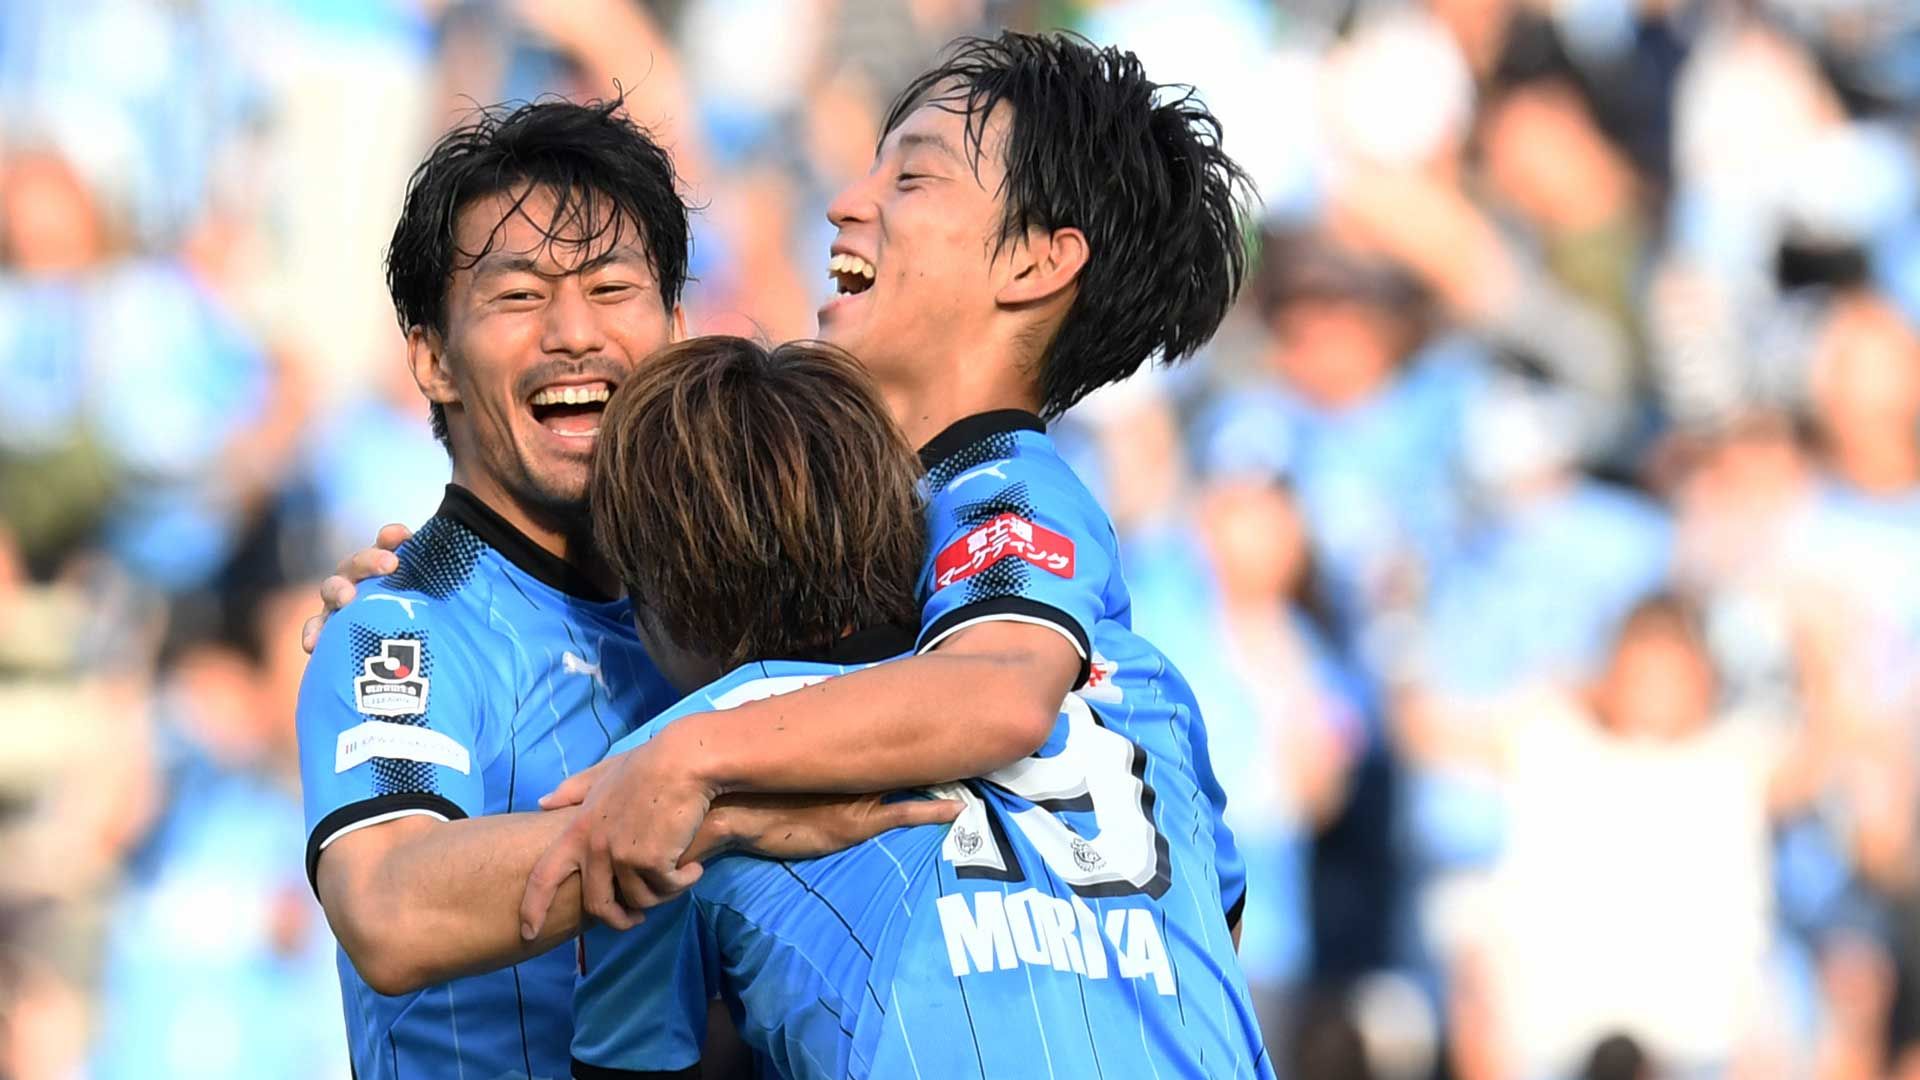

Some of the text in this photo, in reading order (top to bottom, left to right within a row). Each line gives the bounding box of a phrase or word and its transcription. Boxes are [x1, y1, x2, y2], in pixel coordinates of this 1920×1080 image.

[937, 530, 1070, 586] マーケティング
[936, 888, 1177, 996] MORIYA
